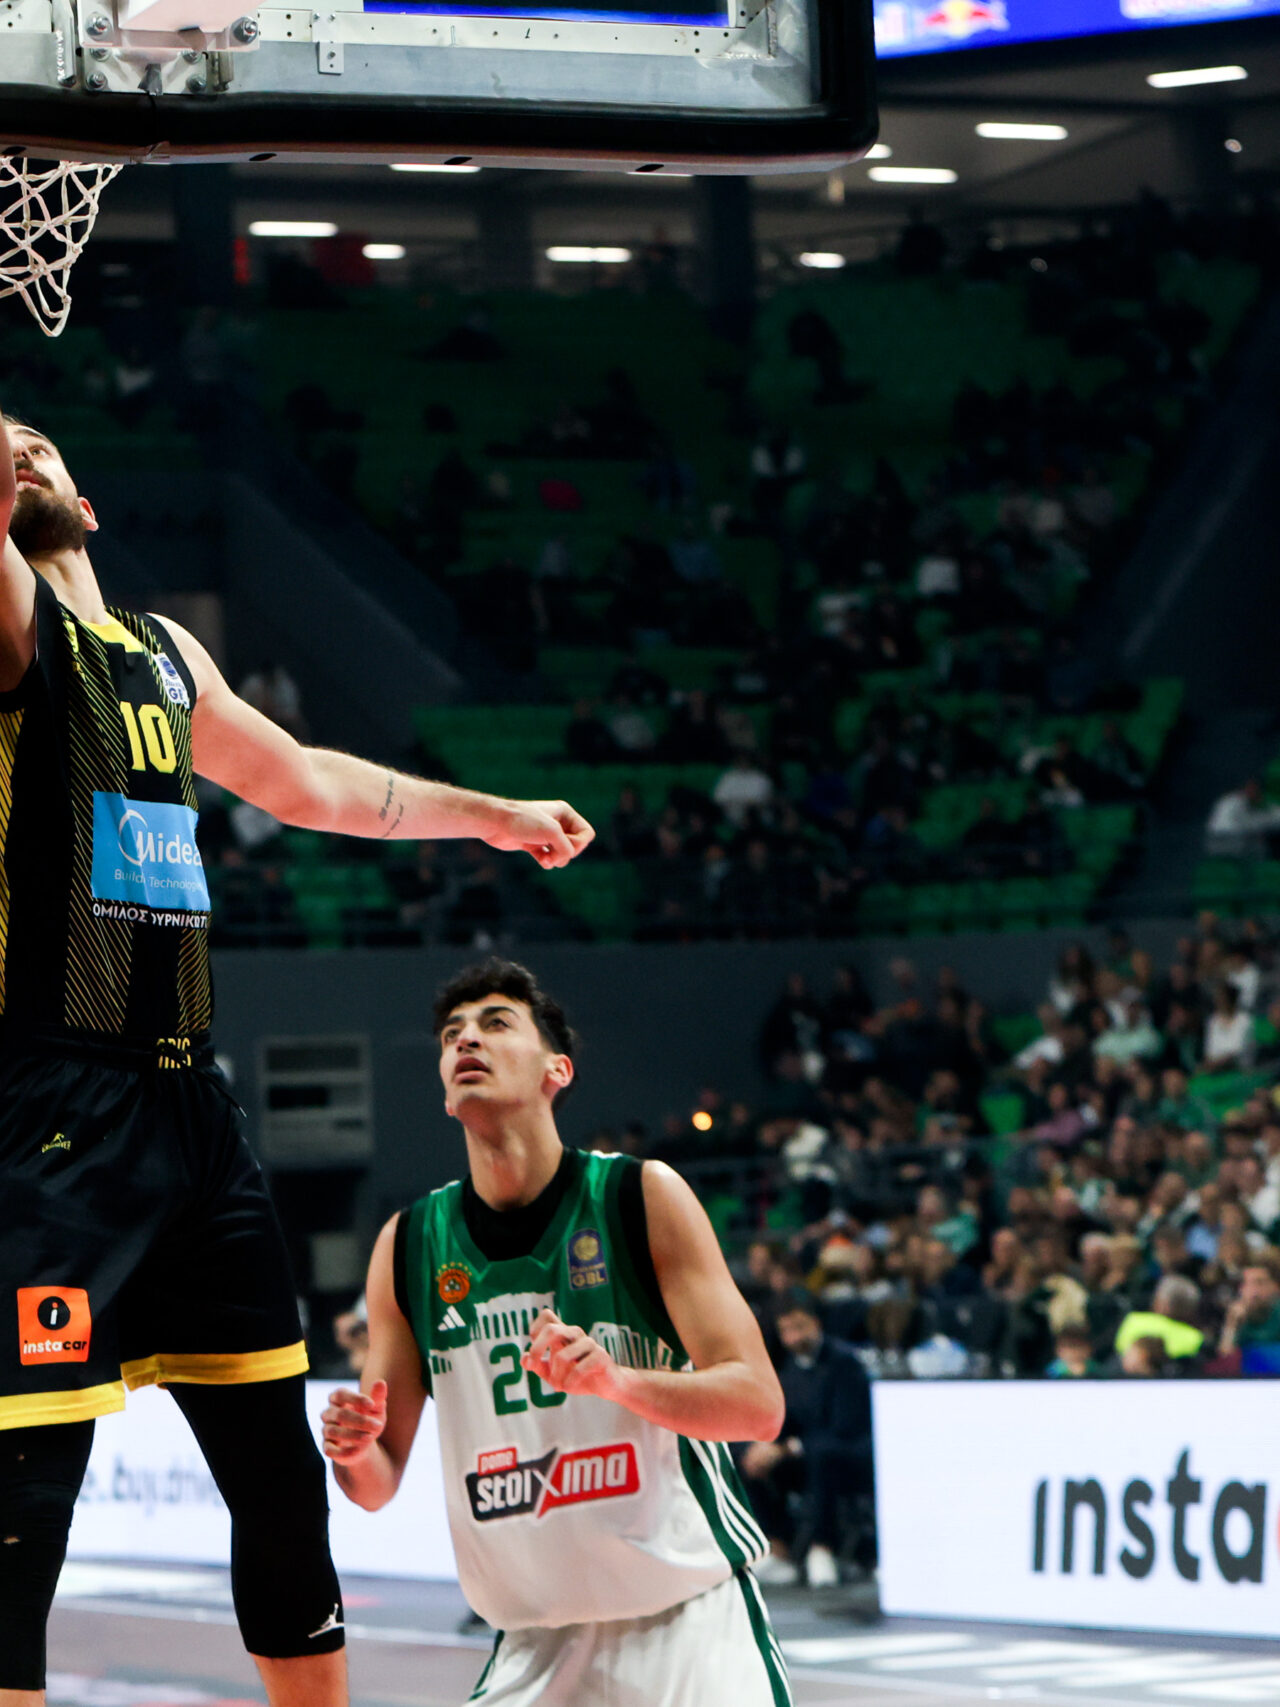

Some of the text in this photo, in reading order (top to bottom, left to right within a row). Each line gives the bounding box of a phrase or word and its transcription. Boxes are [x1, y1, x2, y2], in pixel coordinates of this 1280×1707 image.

[120, 701, 177, 774] 10
[118, 831, 203, 867] Midea
[23, 1339, 87, 1354] instacar
[480, 1451, 514, 1474] pame
[1032, 1445, 1280, 1584] insta
